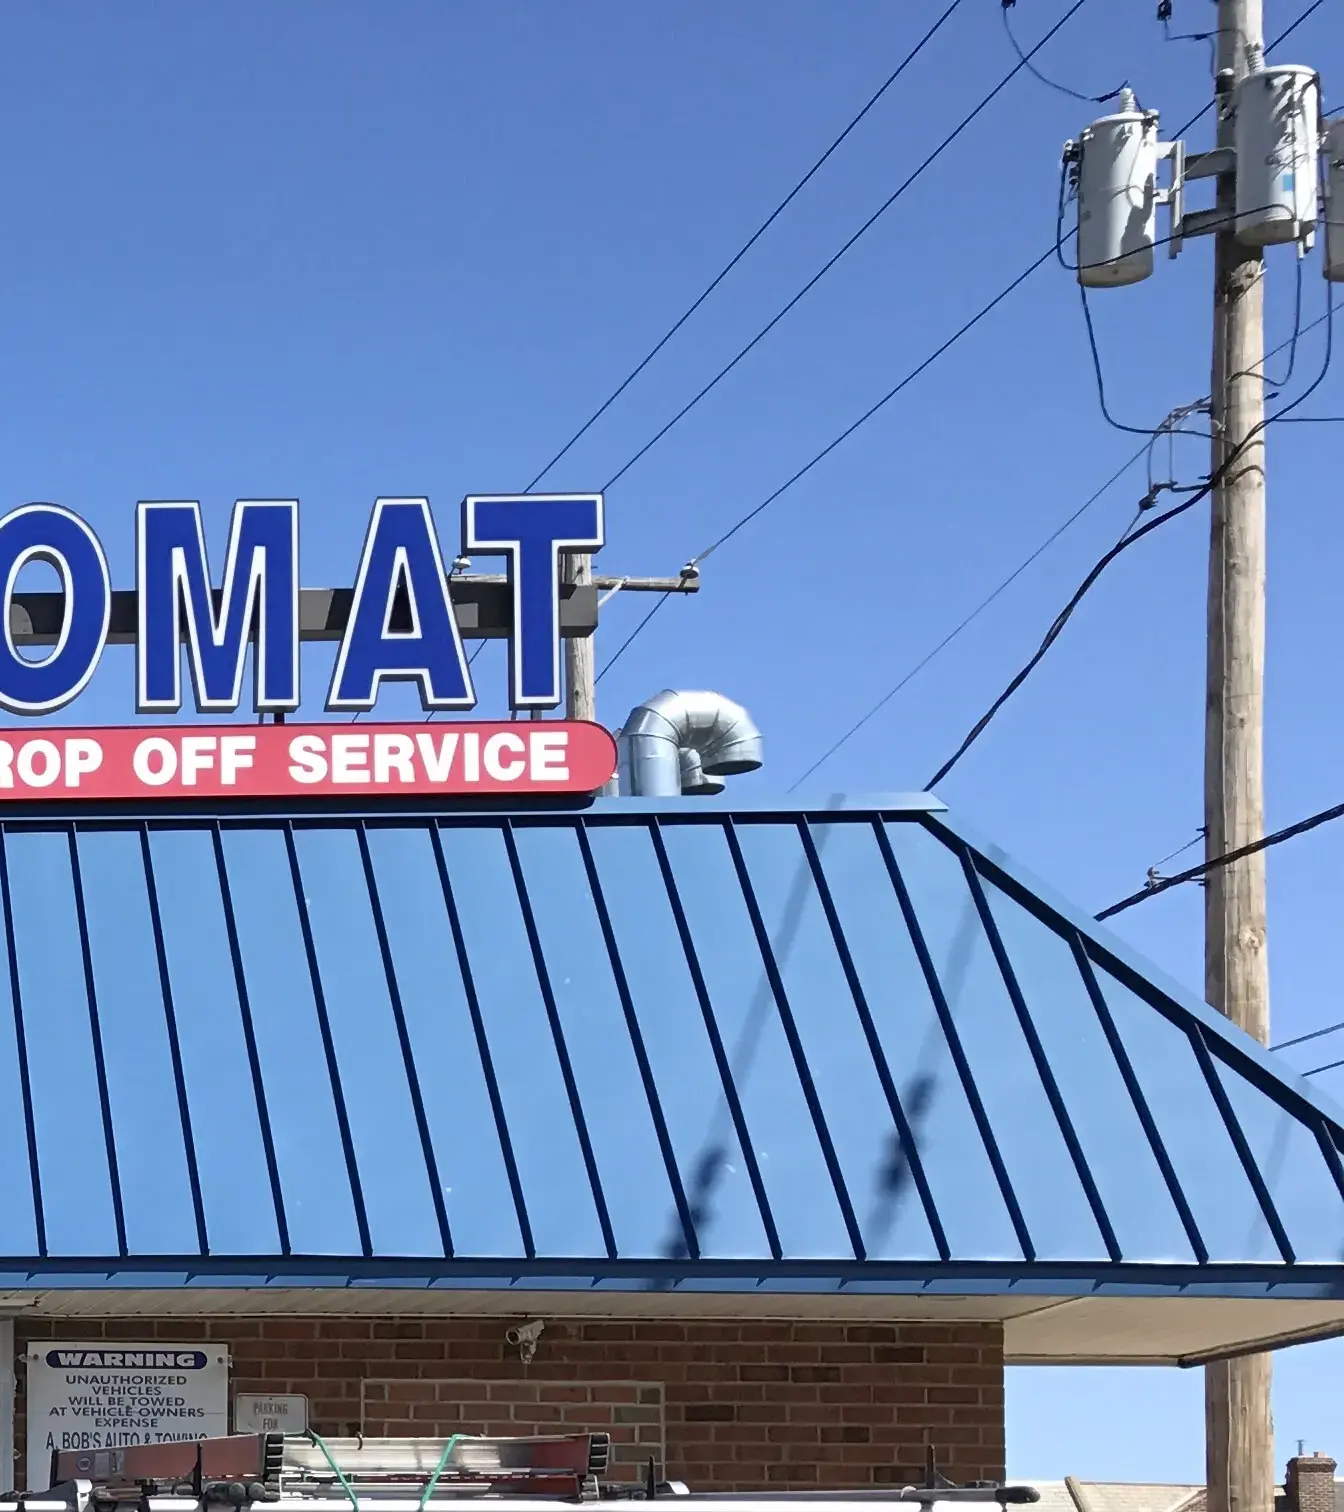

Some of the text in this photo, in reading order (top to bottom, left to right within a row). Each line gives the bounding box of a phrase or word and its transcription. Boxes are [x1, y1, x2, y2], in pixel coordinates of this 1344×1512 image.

[133, 735, 256, 786] OFF
[287, 731, 570, 784] SERVICE
[57, 1353, 196, 1367] WARNING
[65, 1375, 187, 1385] UNAUTHORIZED
[91, 1385, 162, 1396] VEHICLES
[68, 1396, 185, 1407] WILL BE TOWED
[48, 1407, 205, 1418] AT VEHICLE OWNERS
[252, 1402, 288, 1415] PARKING
[95, 1417, 158, 1428] EXPENSE
